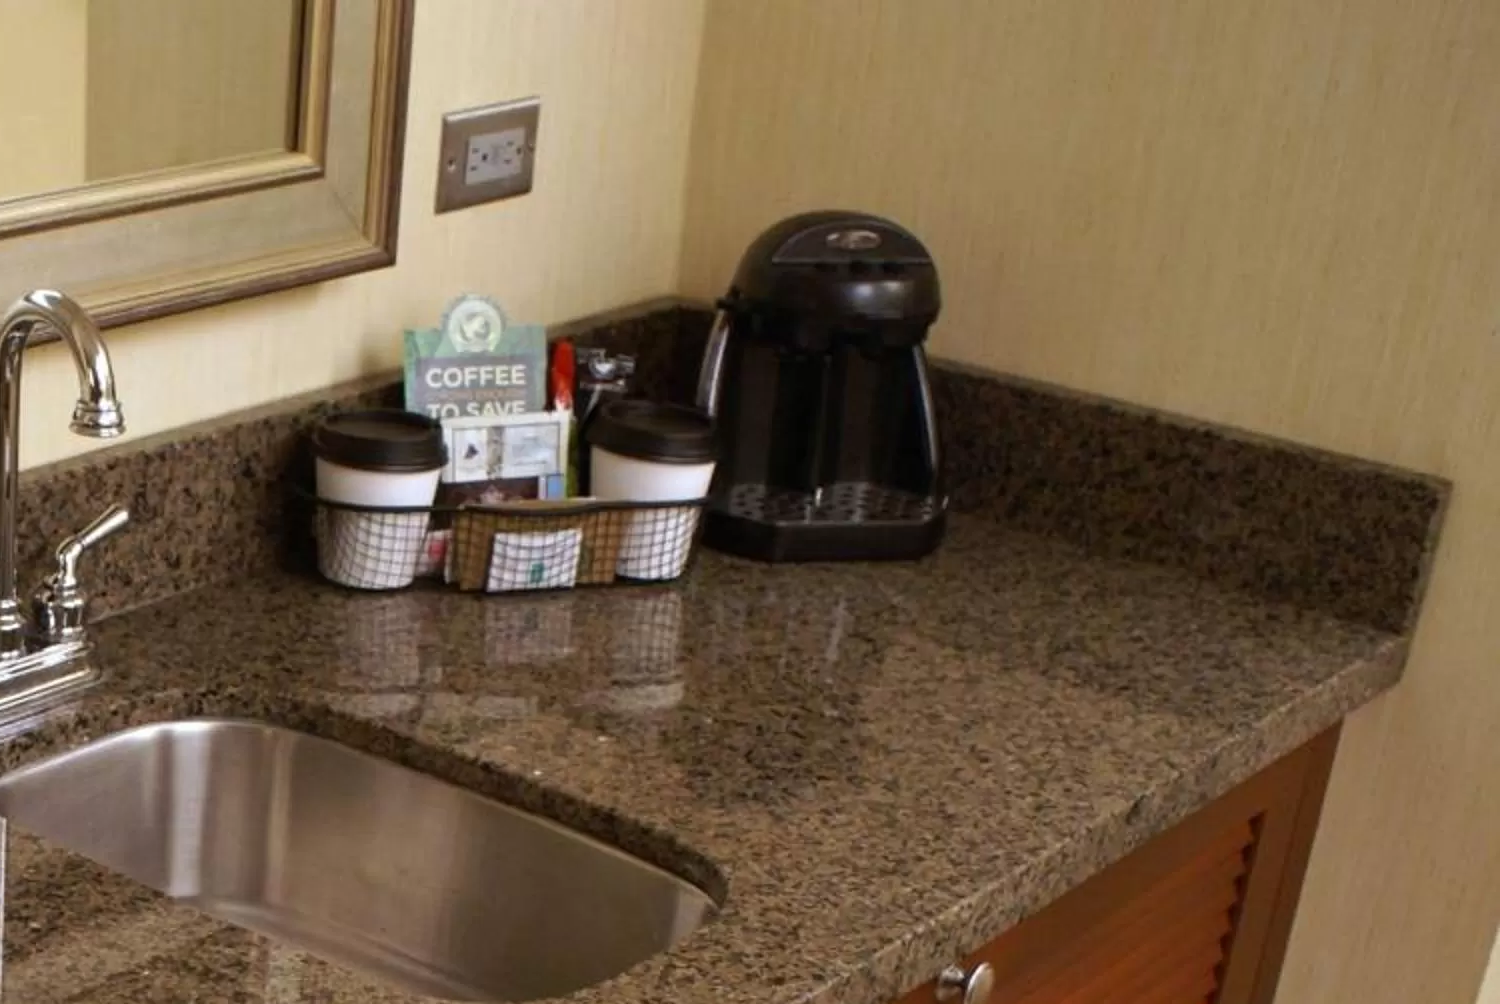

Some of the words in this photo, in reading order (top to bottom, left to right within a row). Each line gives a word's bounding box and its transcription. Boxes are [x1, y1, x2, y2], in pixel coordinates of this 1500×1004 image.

[425, 364, 527, 388] COFFEE
[427, 401, 460, 419] TO
[466, 400, 526, 417] SAVE
